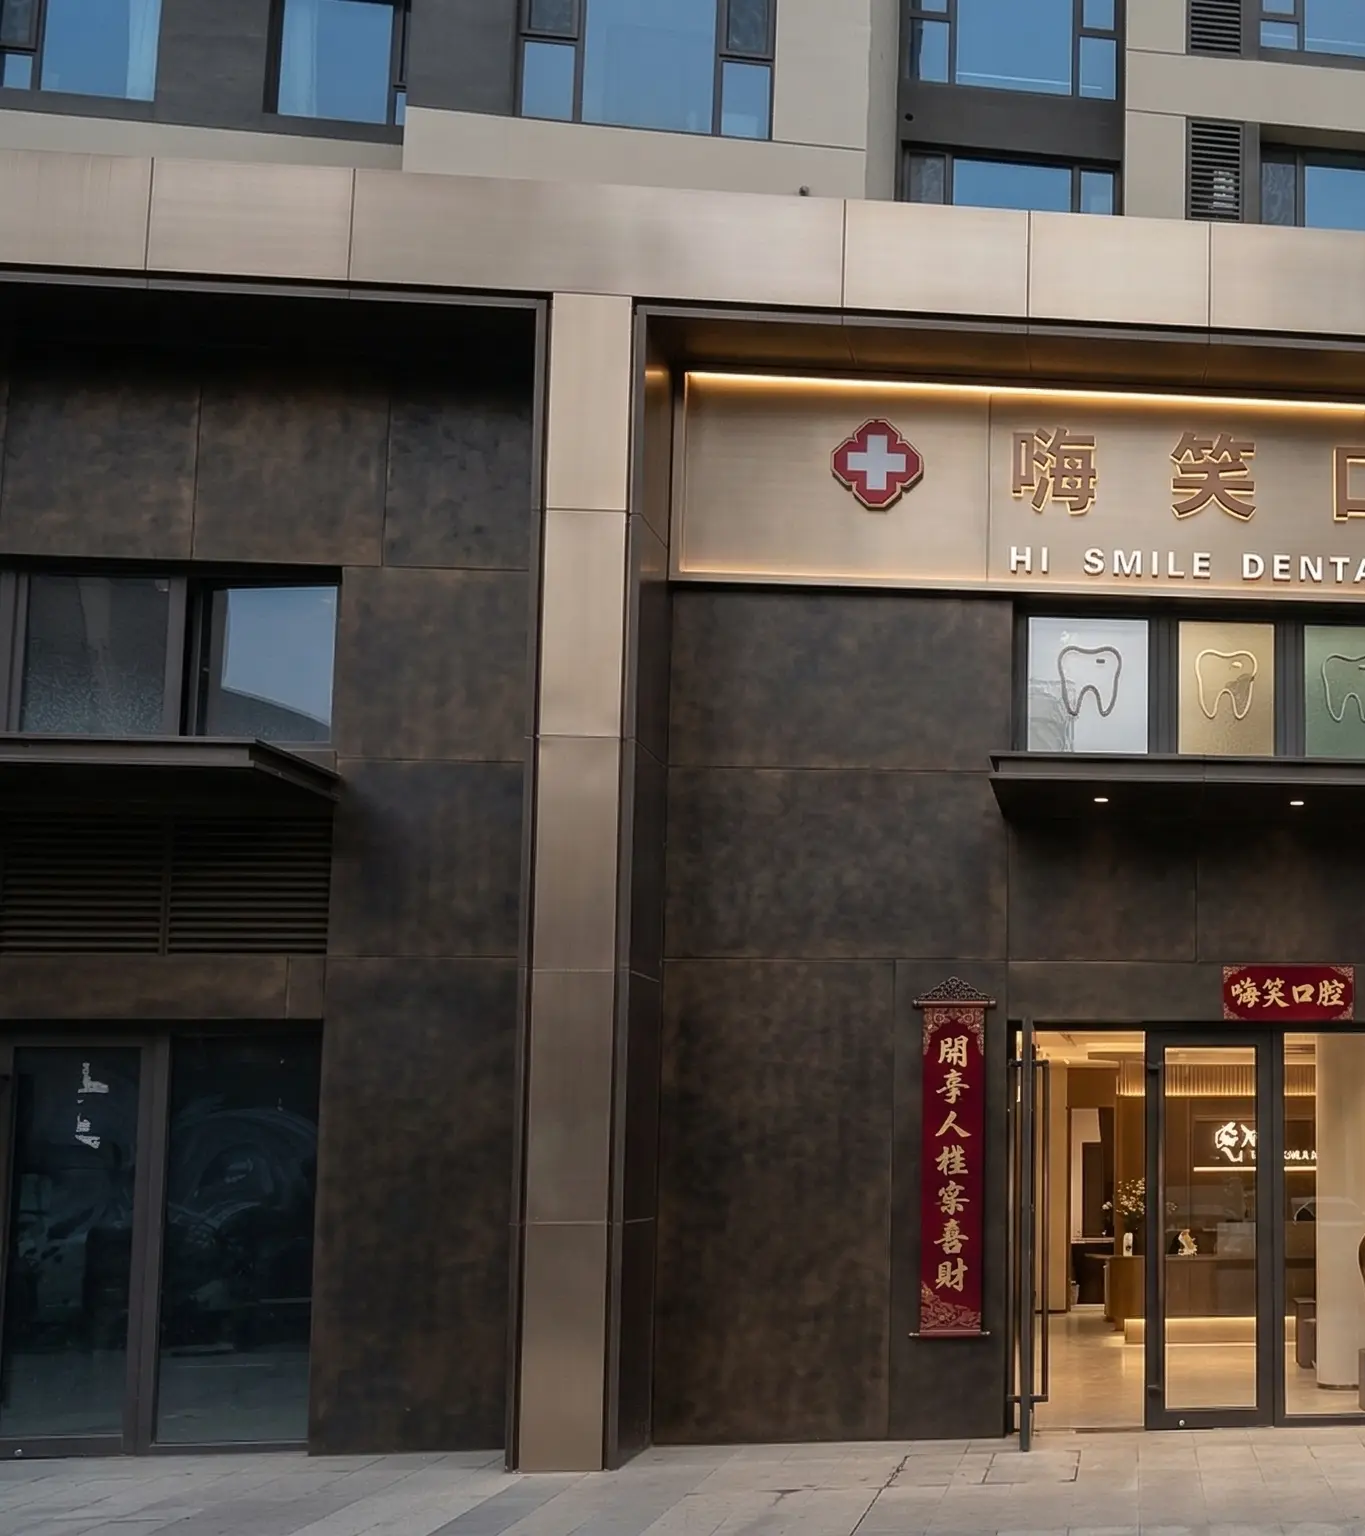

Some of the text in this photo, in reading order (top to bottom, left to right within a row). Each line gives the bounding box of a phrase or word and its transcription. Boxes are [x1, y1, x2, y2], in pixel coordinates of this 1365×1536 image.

[1009, 546, 1049, 575] HI
[1083, 548, 1212, 579] SMILE
[1230, 976, 1346, 1009] 嗨笑口腔
